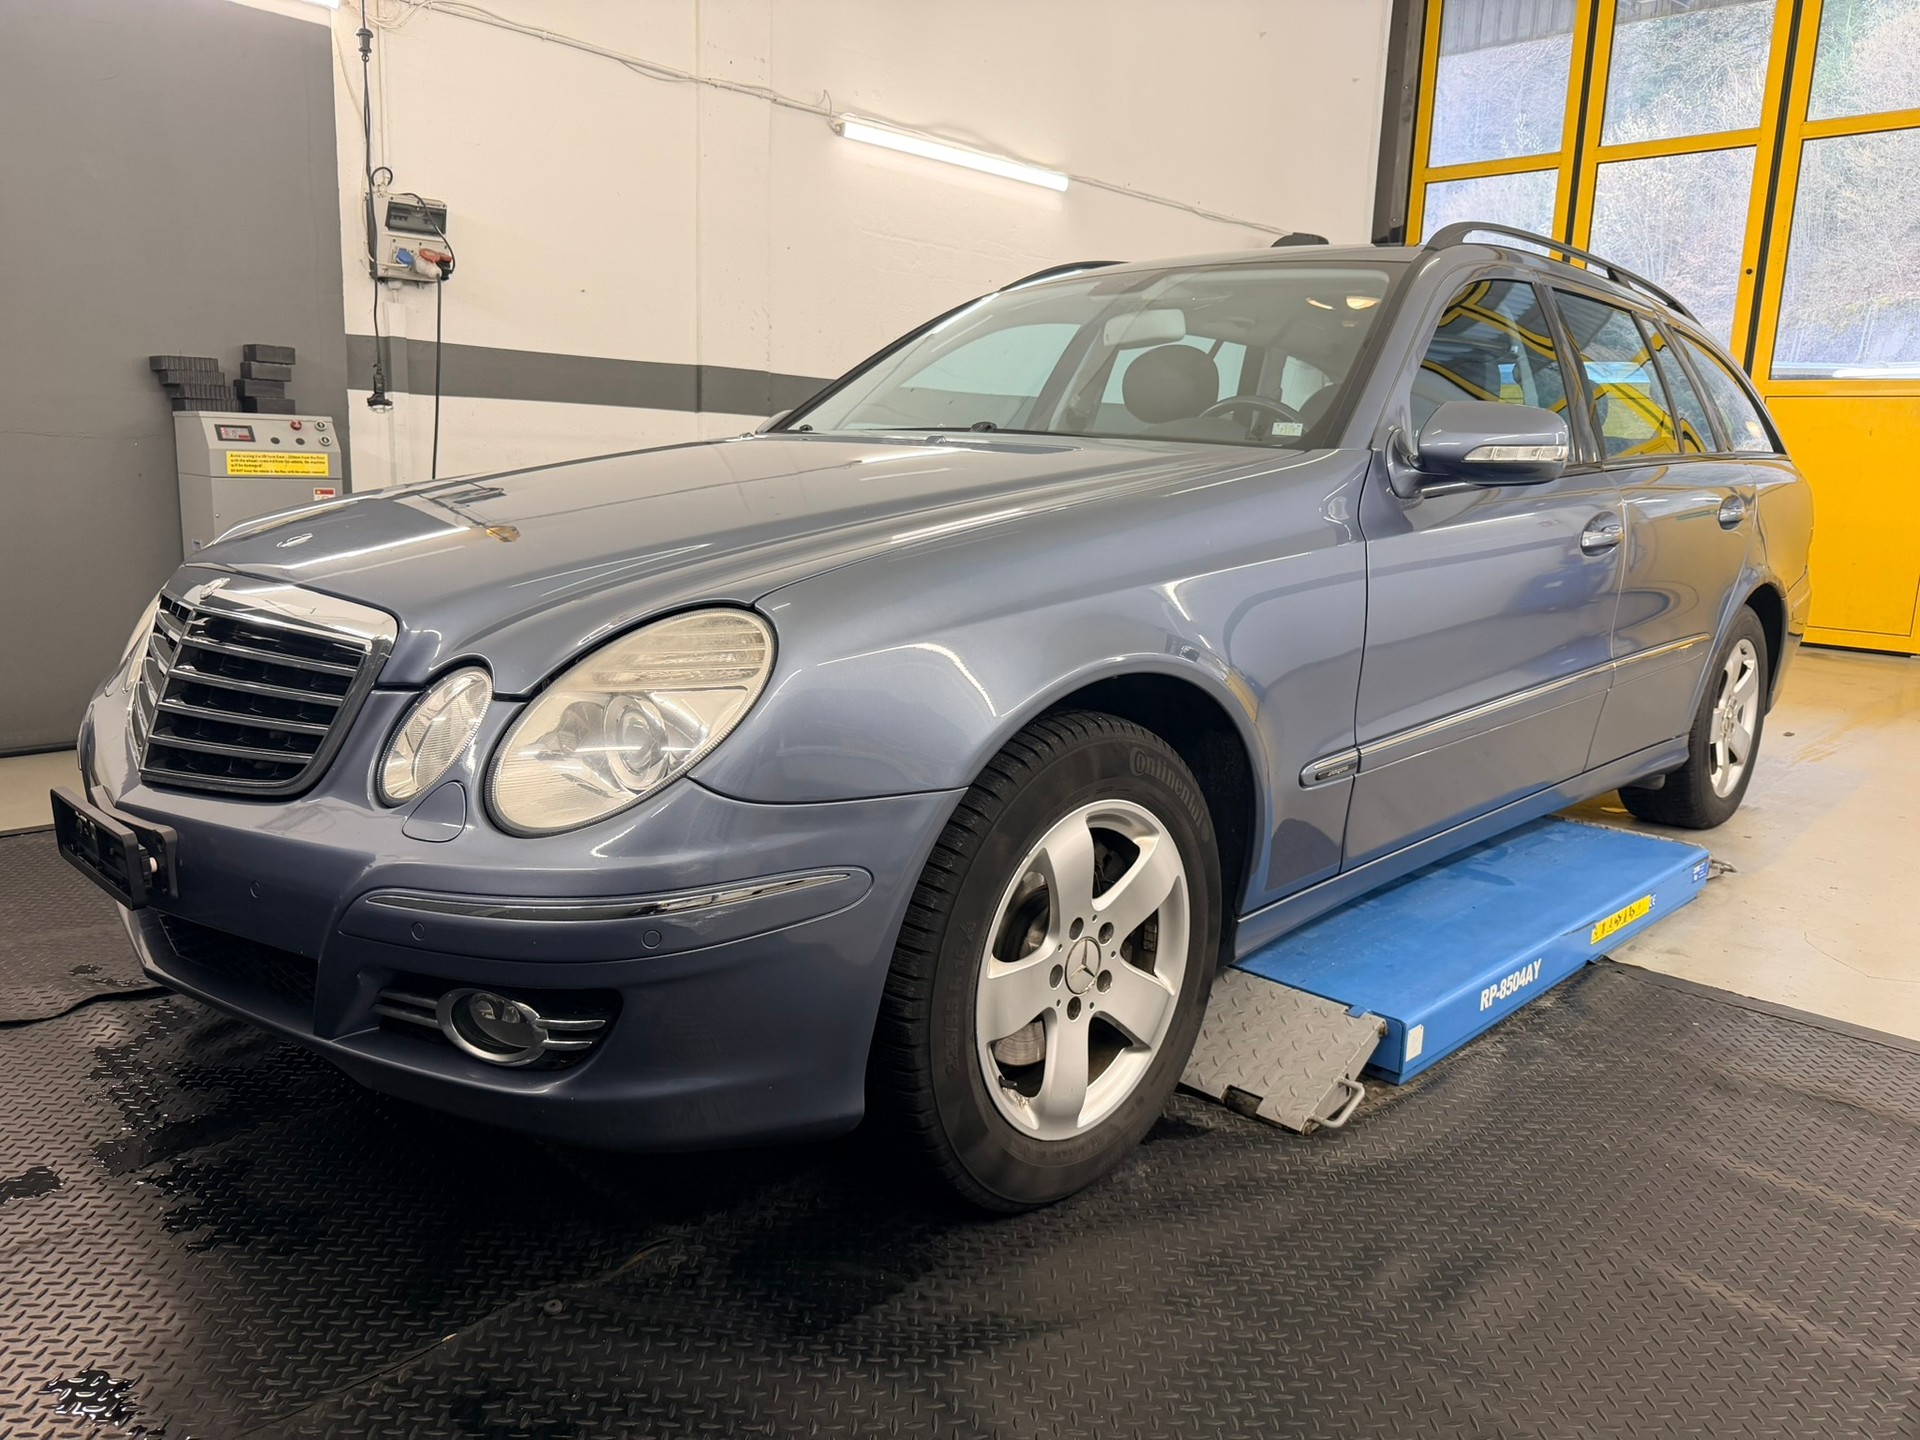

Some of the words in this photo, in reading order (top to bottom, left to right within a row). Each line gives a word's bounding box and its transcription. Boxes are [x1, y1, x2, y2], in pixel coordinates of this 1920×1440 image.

[1129, 746, 1204, 827] Continental
[949, 976, 963, 991] R
[1480, 958, 1542, 1011] RP-8504AY
